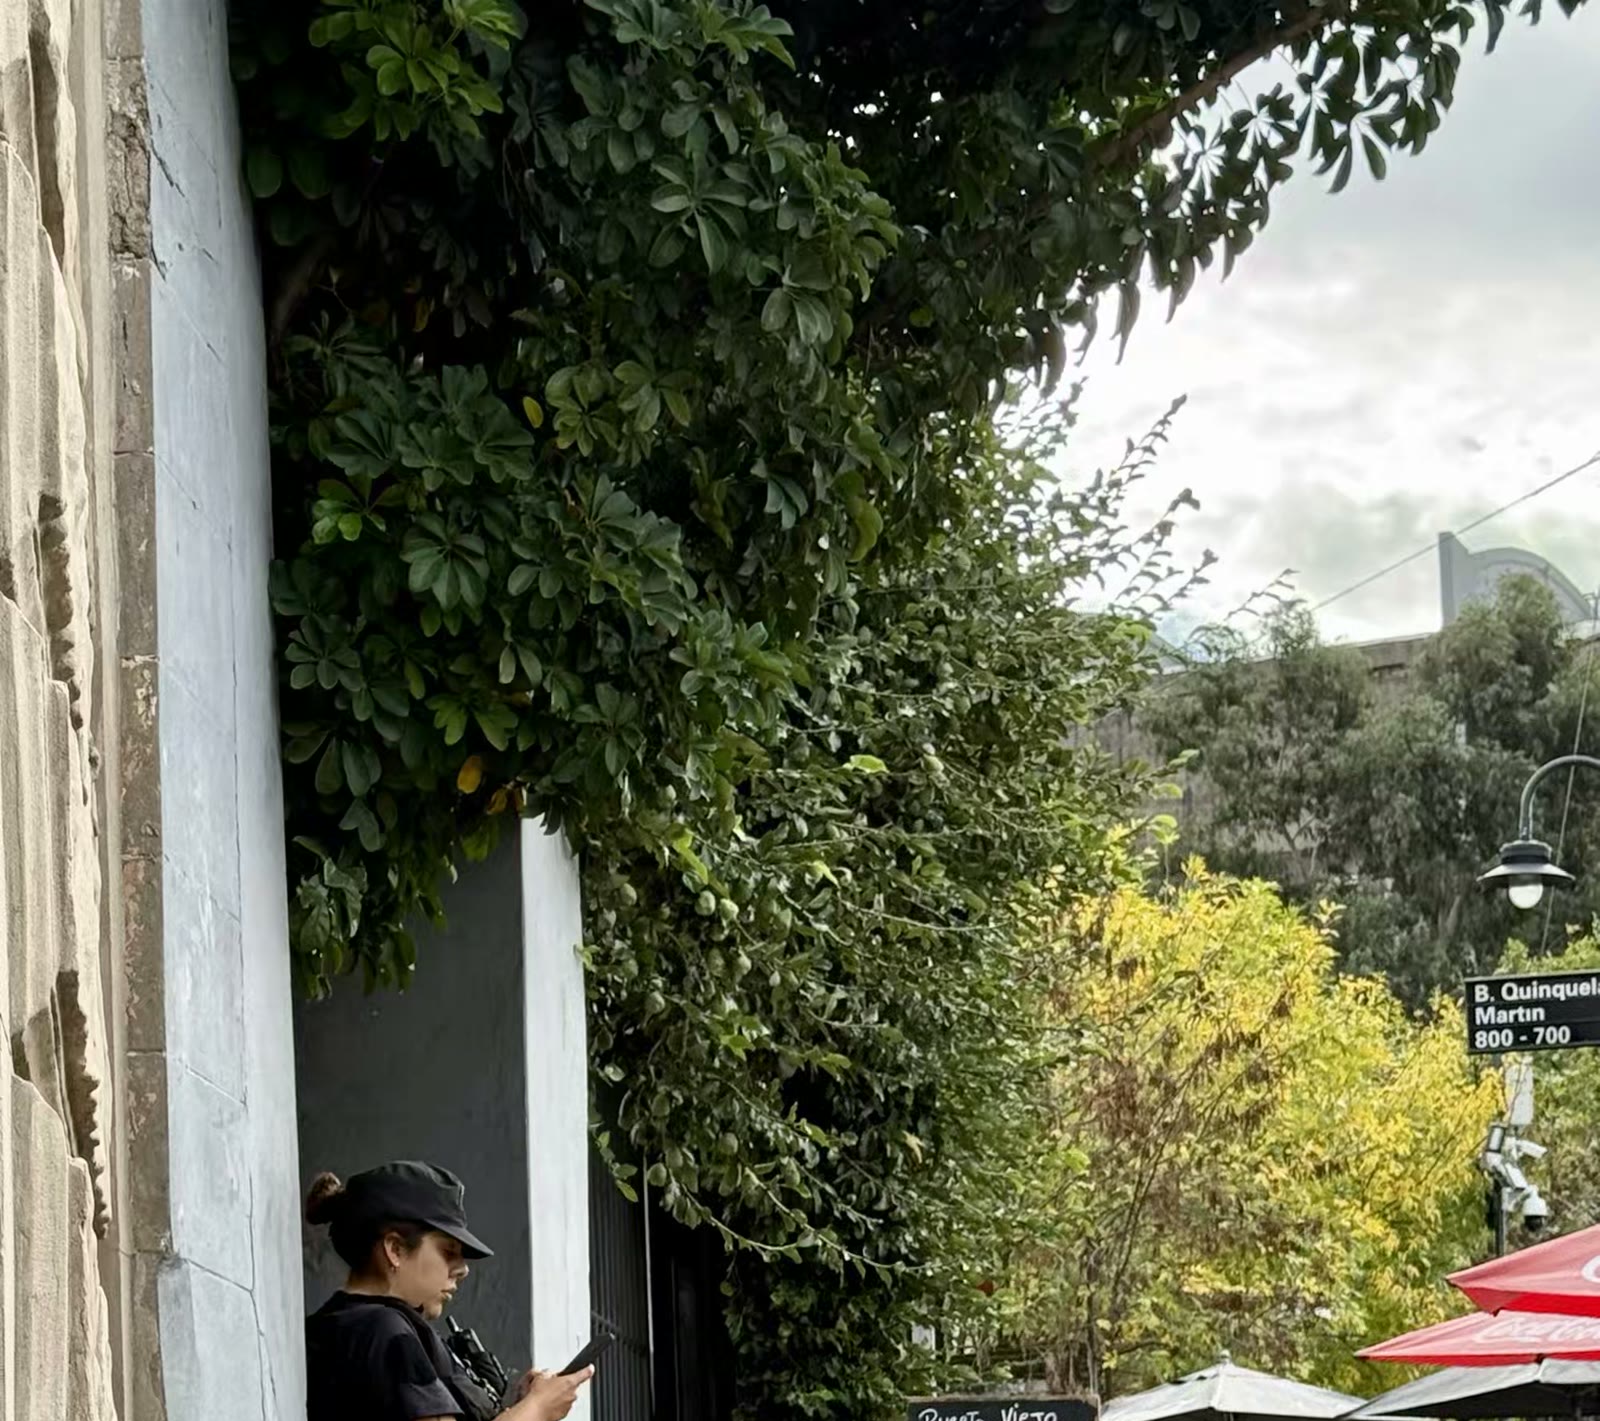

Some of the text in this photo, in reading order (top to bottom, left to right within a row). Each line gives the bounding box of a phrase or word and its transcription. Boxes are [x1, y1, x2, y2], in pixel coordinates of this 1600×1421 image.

[1474, 977, 1600, 1003] B. Quinquel
[1475, 1028, 1514, 1048] 800
[1533, 1025, 1571, 1045] 700
